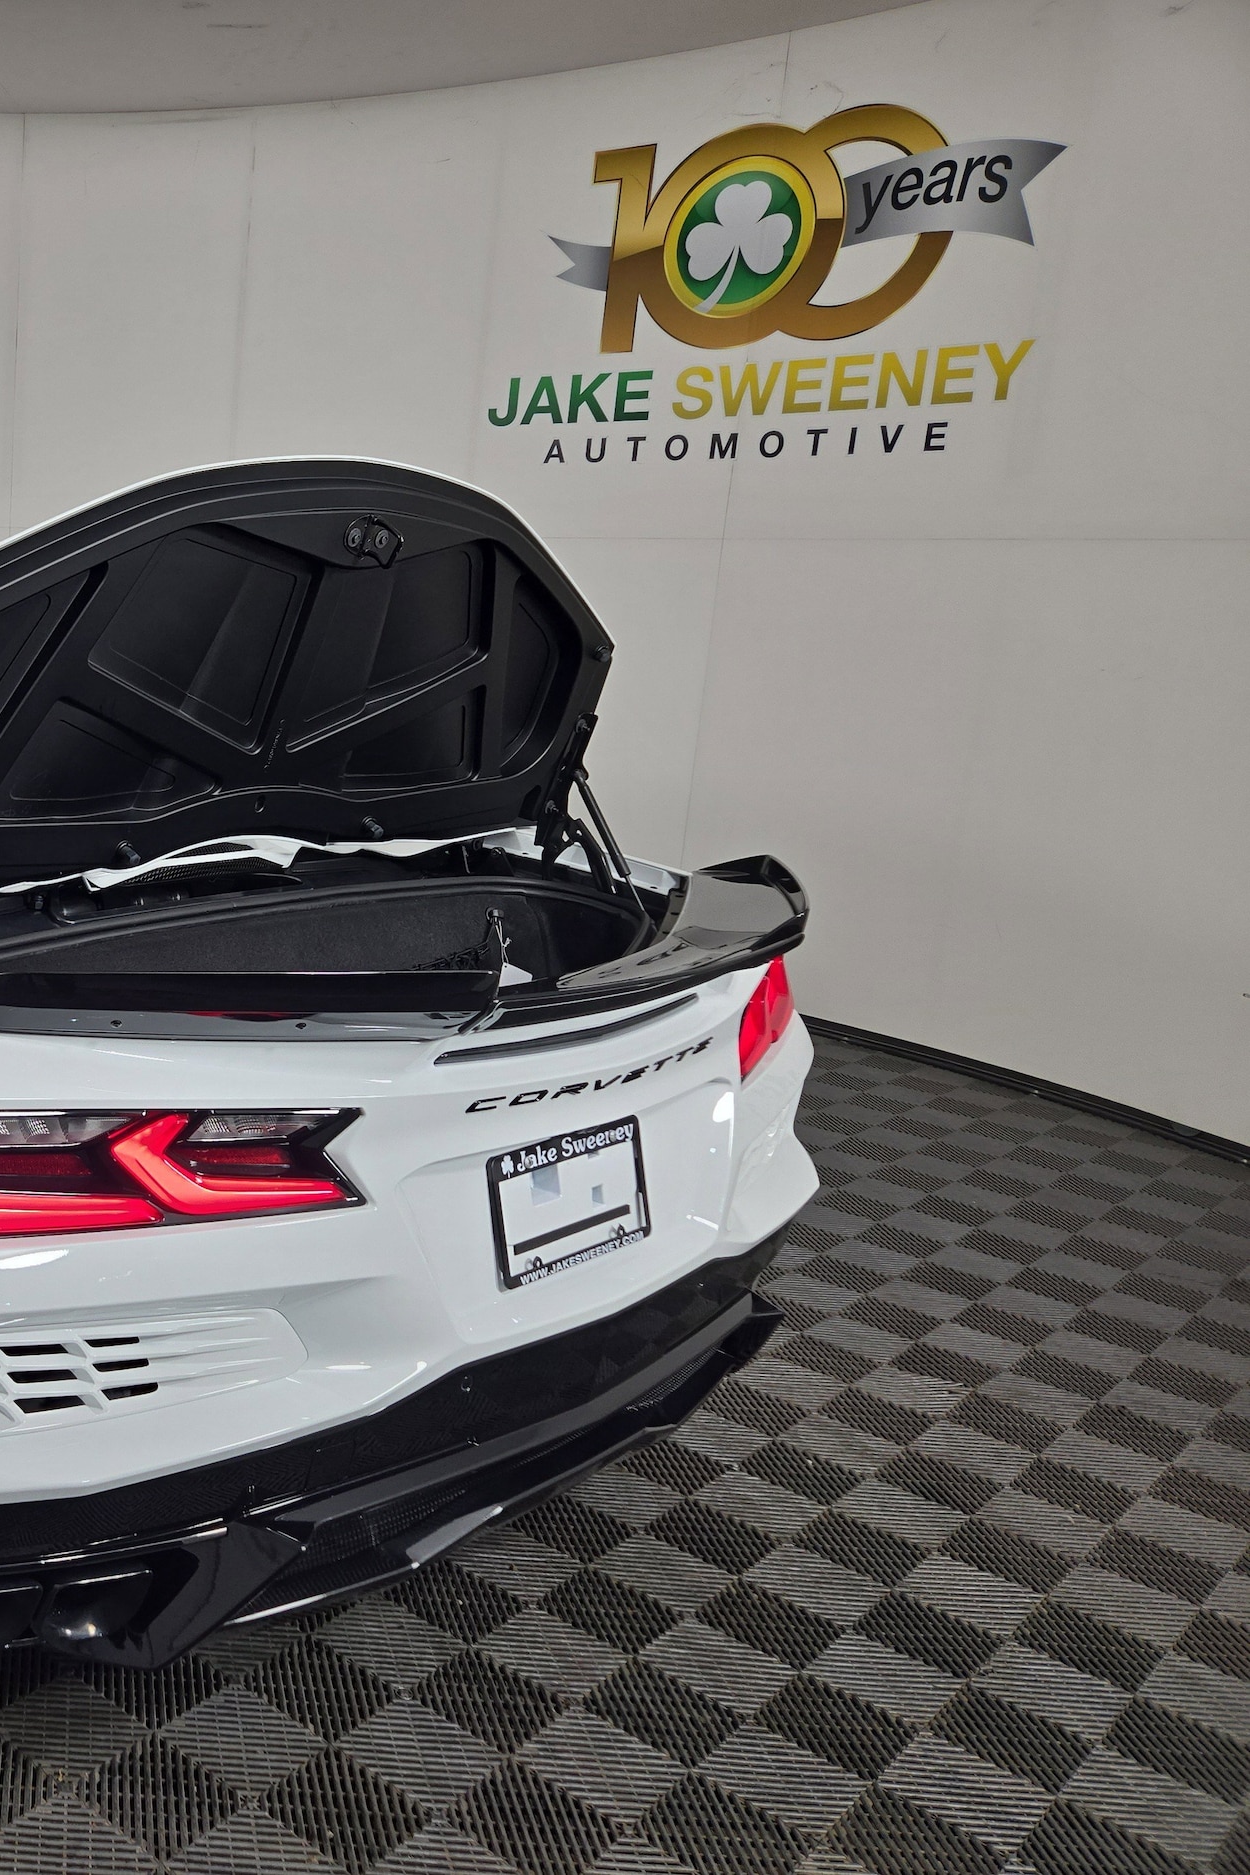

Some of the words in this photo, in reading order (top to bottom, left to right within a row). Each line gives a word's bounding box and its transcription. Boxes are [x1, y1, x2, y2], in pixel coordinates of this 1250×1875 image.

[593, 103, 954, 354] 100
[854, 153, 1012, 236] years
[487, 370, 654, 427] JAKE
[671, 339, 1037, 420] SWEENEY
[543, 421, 950, 465] AUTOMOTIVE
[465, 1036, 714, 1114] CORVETTE
[517, 1145, 558, 1172] Jake
[519, 1230, 645, 1286] WWW.JAKESWEENEY.COM
